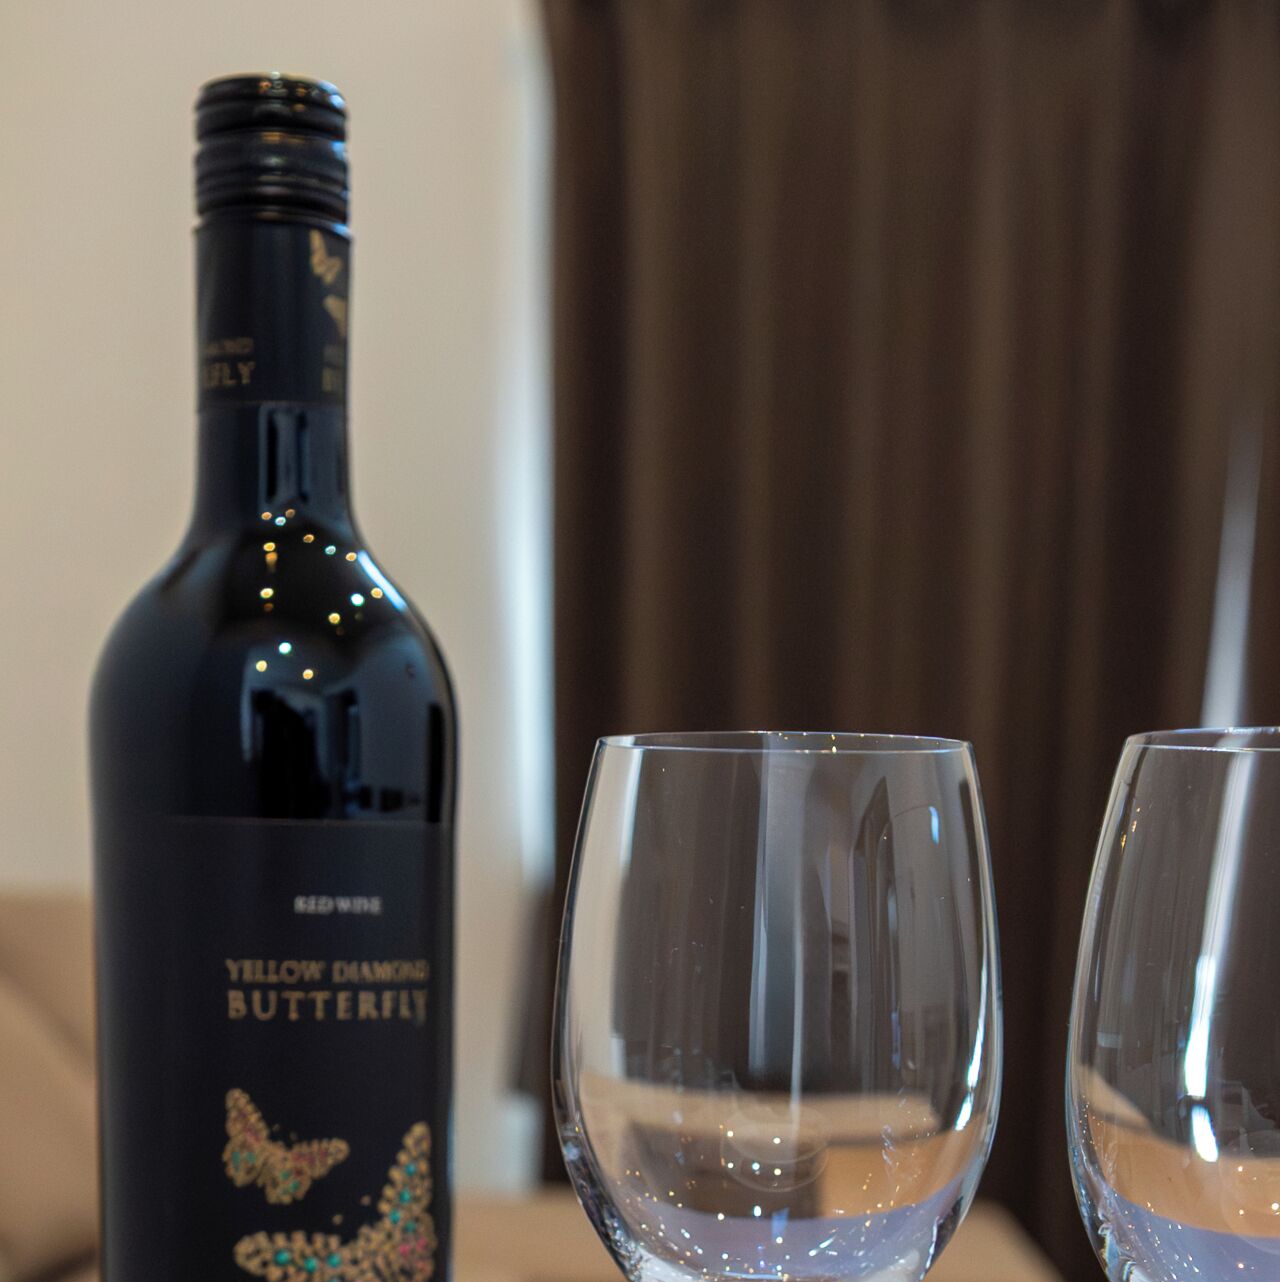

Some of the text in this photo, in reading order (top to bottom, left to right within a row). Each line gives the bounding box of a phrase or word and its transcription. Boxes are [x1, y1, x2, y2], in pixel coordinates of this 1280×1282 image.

[294, 895, 382, 915] RED WINE
[224, 958, 430, 984] YELLOW DIAMOND
[227, 989, 428, 1026] BUTTERFLY
